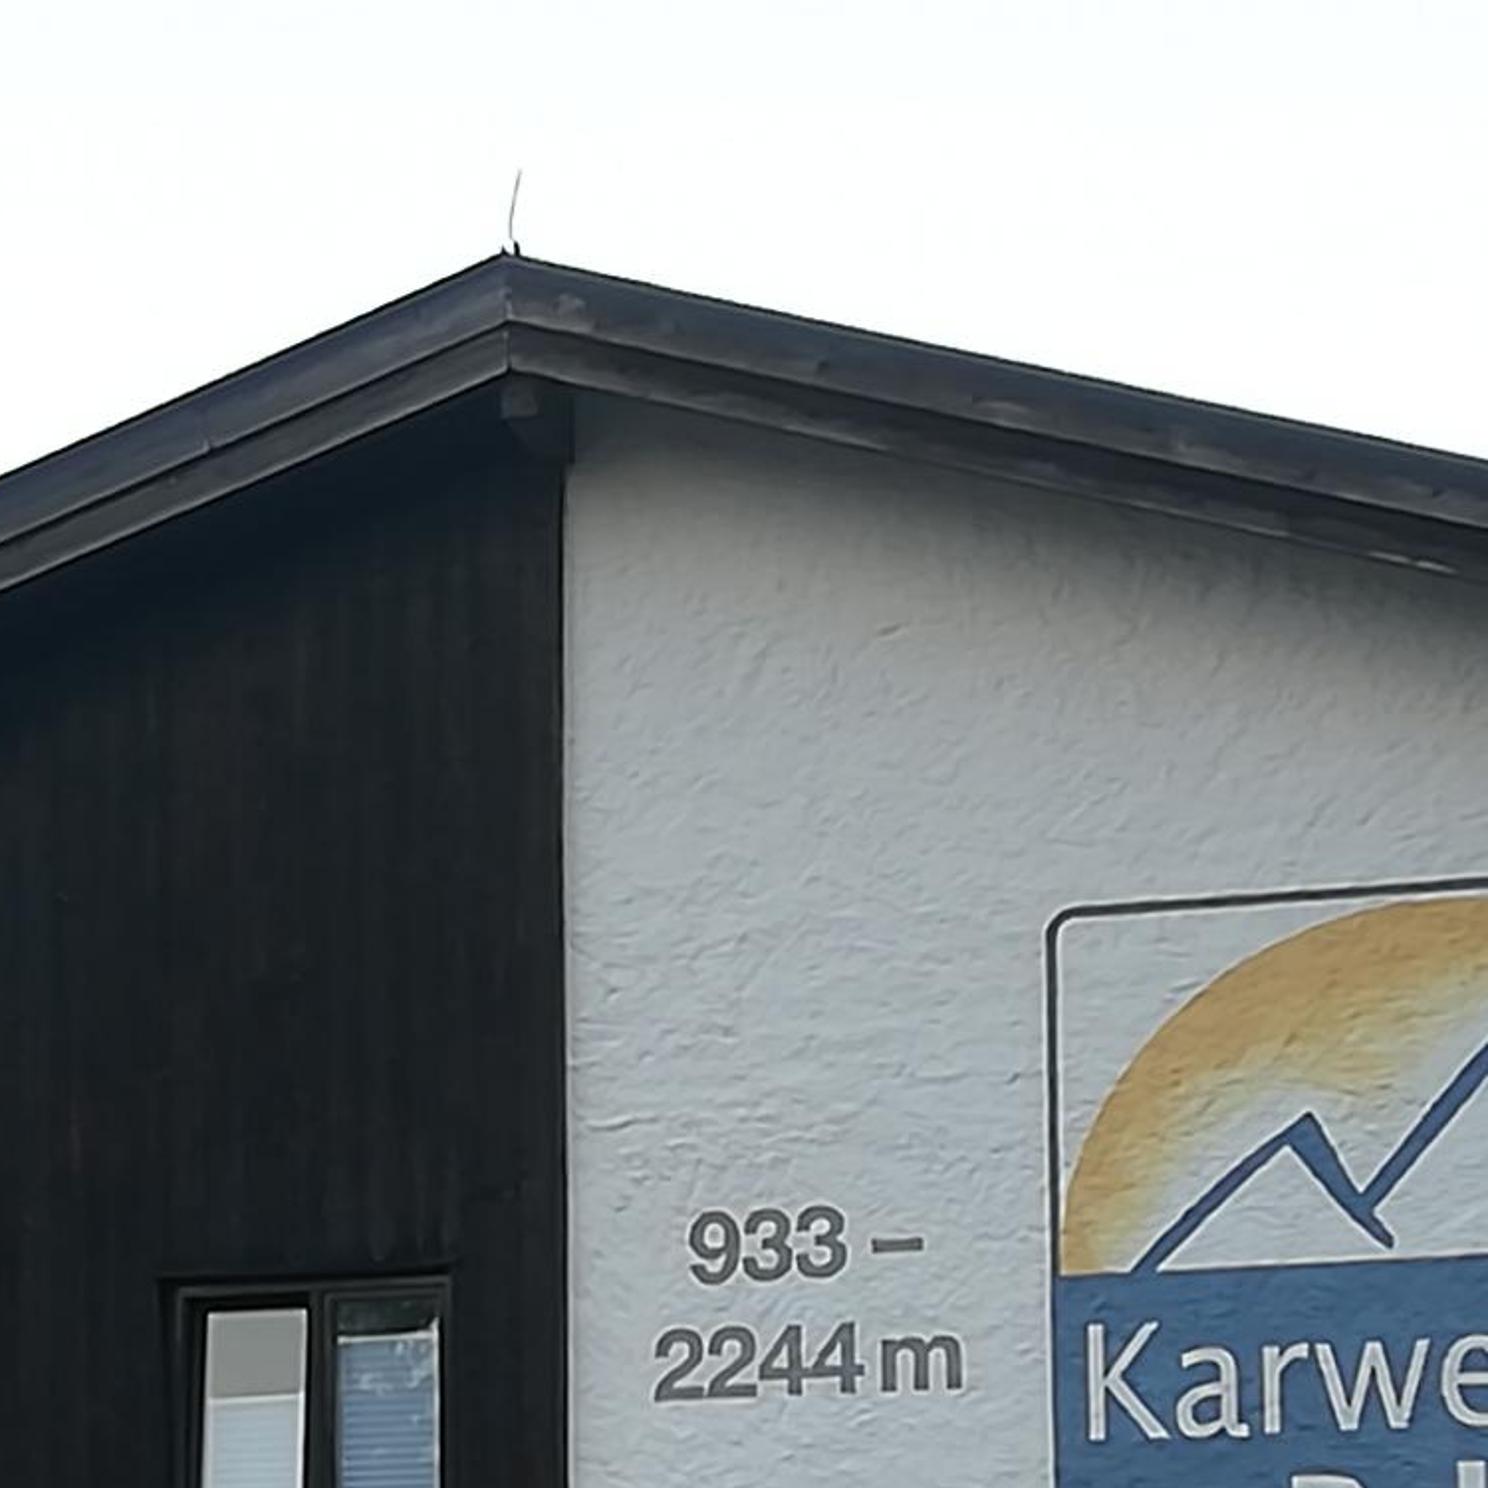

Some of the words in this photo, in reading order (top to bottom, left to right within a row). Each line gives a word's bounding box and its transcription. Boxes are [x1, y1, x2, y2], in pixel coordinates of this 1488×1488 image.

[687, 1204, 849, 1286] 933
[653, 1320, 866, 1403] 2244
[879, 1333, 963, 1394] m
